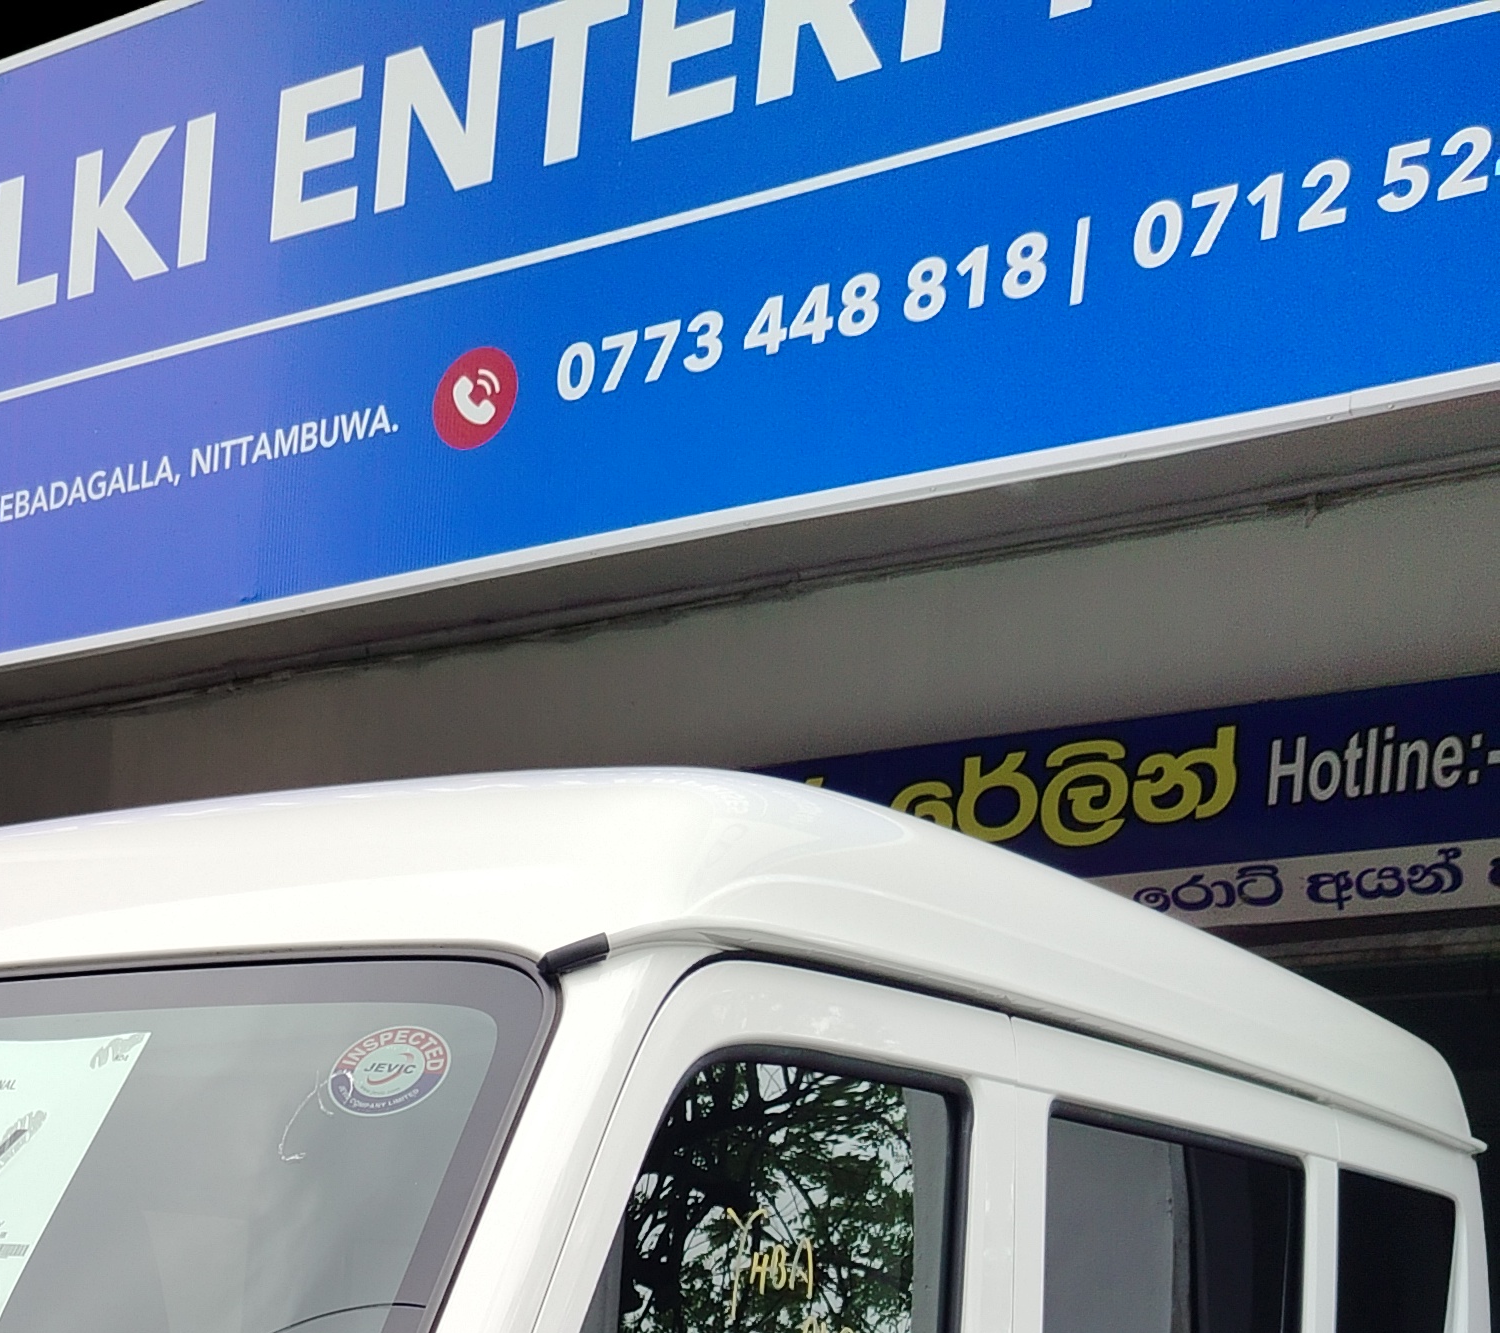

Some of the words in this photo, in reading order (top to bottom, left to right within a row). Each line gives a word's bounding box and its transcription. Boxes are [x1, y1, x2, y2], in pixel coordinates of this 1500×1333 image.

[270, 0, 1092, 243] ENTER
[557, 310, 723, 402] 0773
[743, 272, 881, 357] 448
[904, 232, 1048, 323] 818
[1132, 159, 1353, 268] 0712
[1376, 126, 1500, 212] 52
[190, 403, 401, 480] NITTAMBUWA.
[342, 1030, 445, 1071] INSPECTED
[364, 1062, 417, 1075] JEVIC
[388, 1088, 419, 1106] LIMITED
